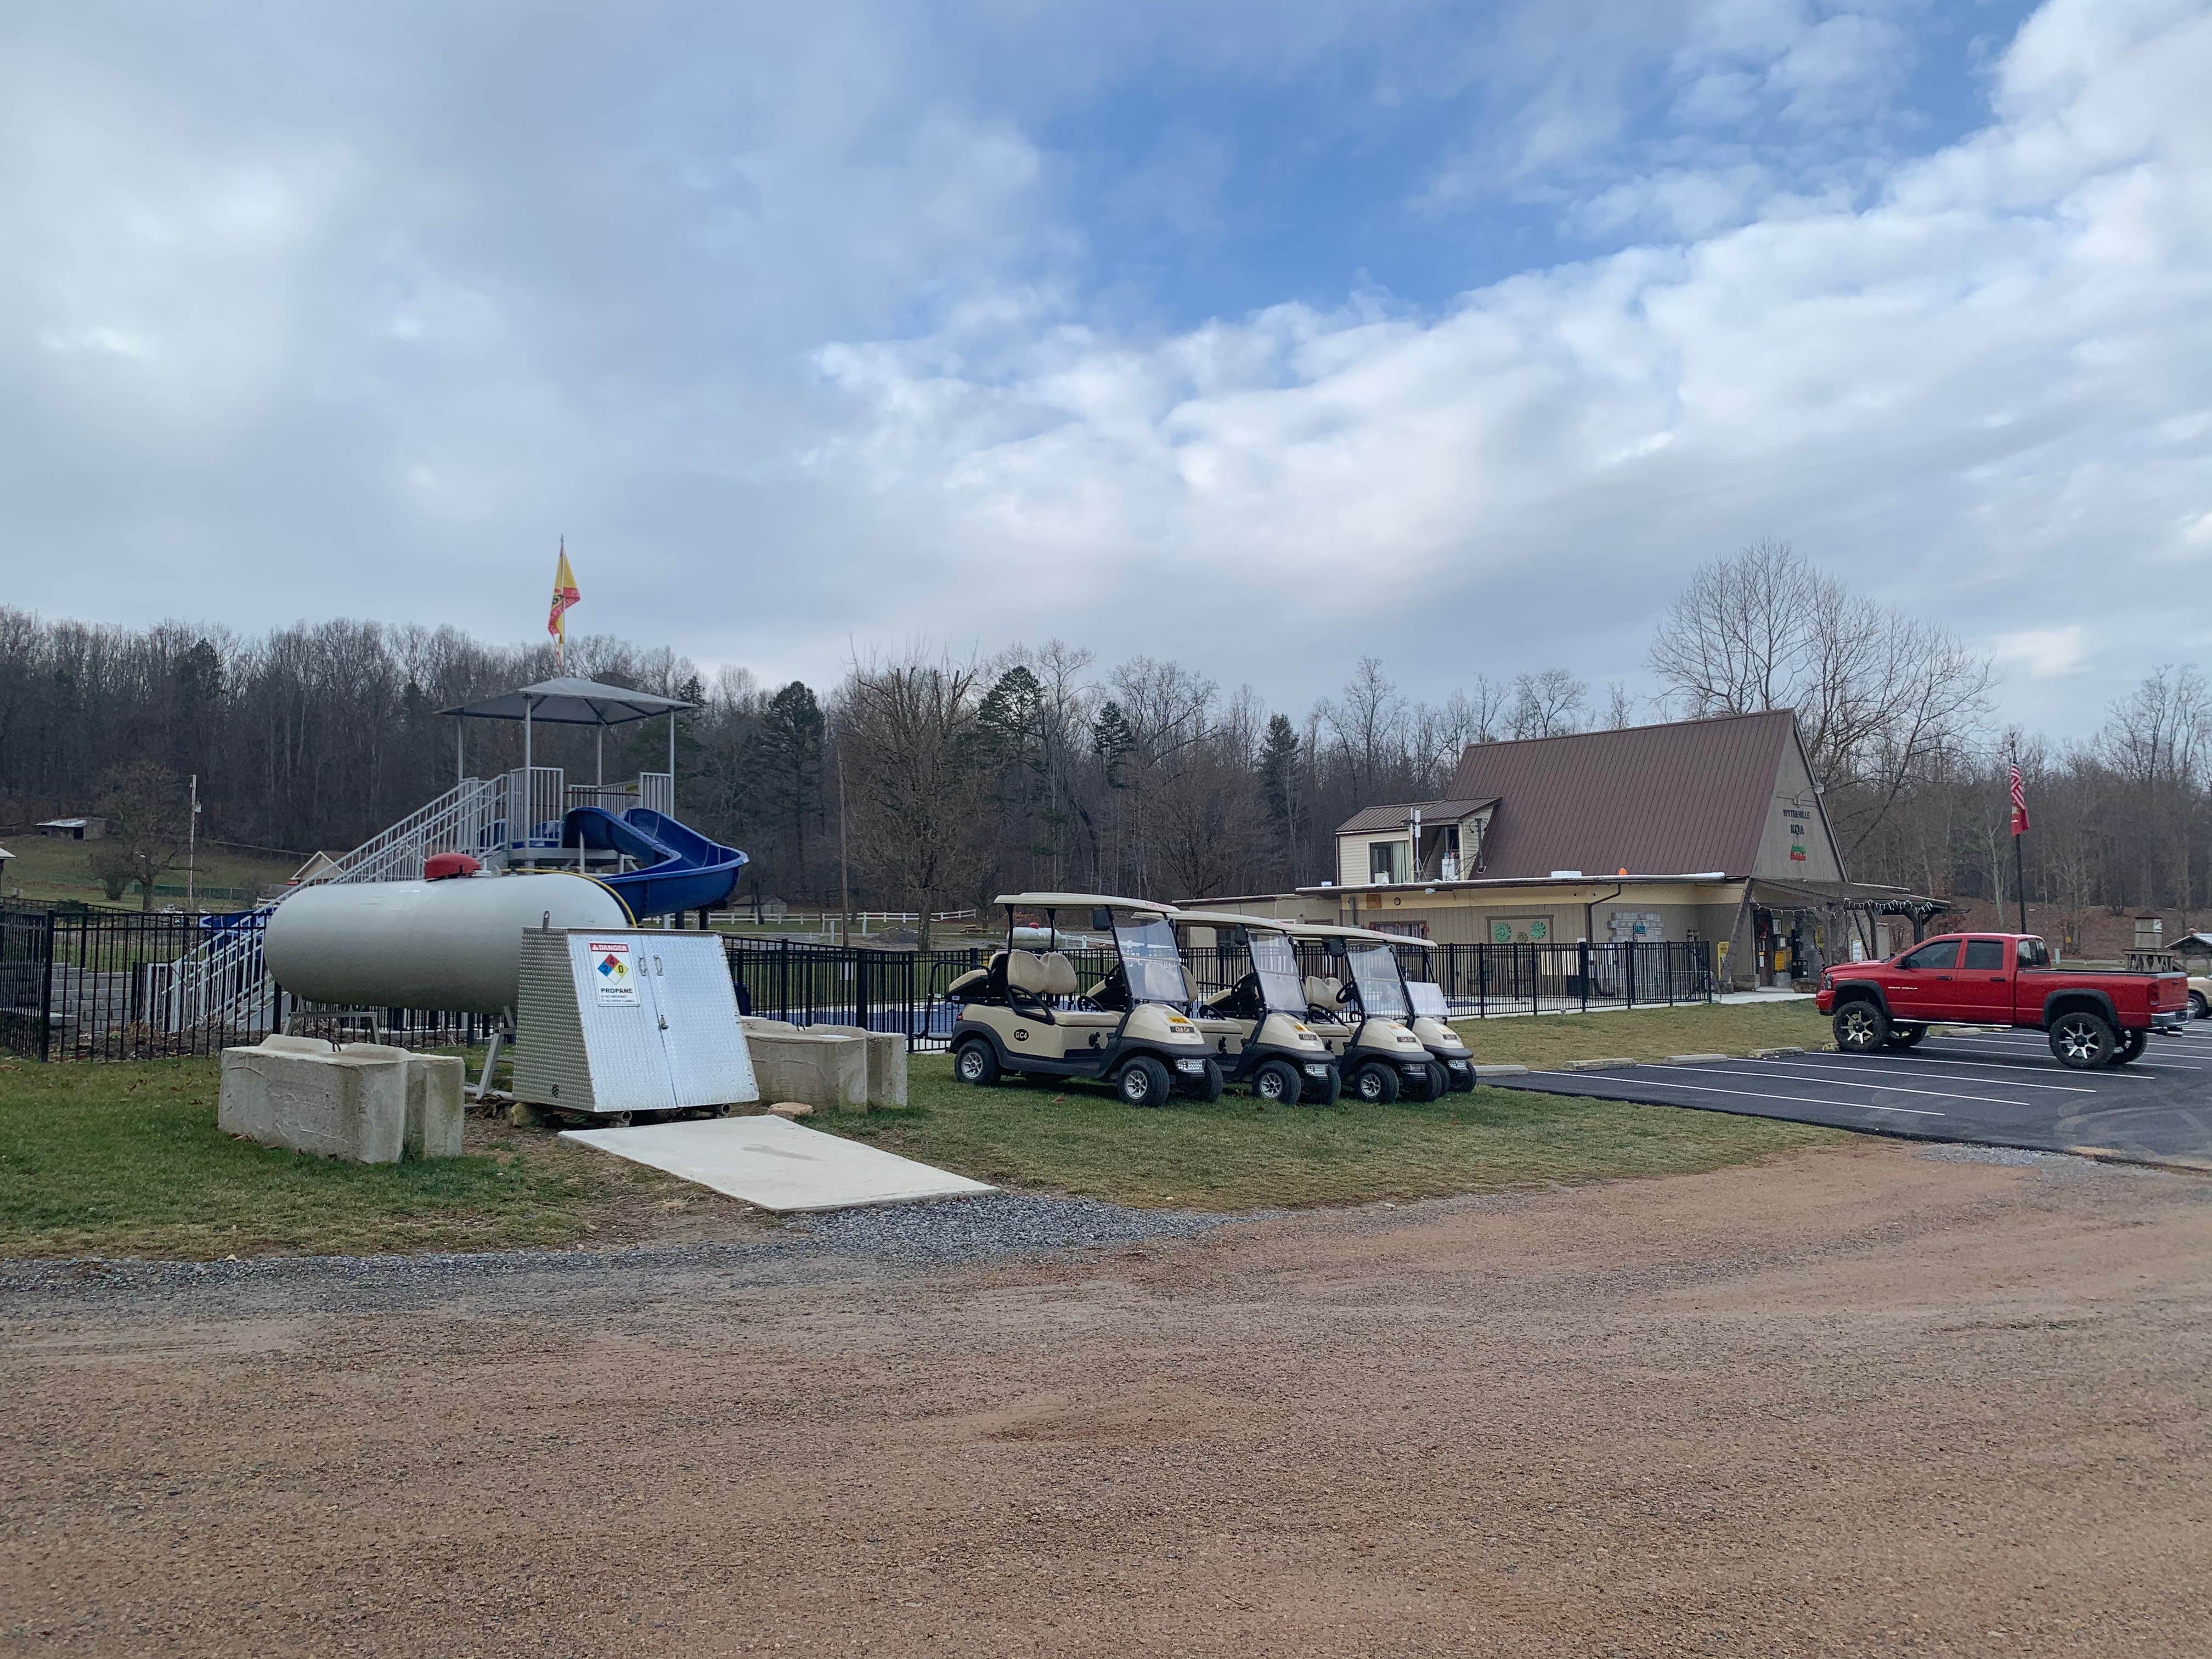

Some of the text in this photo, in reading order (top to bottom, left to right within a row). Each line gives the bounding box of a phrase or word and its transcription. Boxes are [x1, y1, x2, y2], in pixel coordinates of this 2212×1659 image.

[610, 957, 614, 965] 4
[603, 964, 624, 973] 2 0
[1015, 1031, 1028, 1039] GC4
